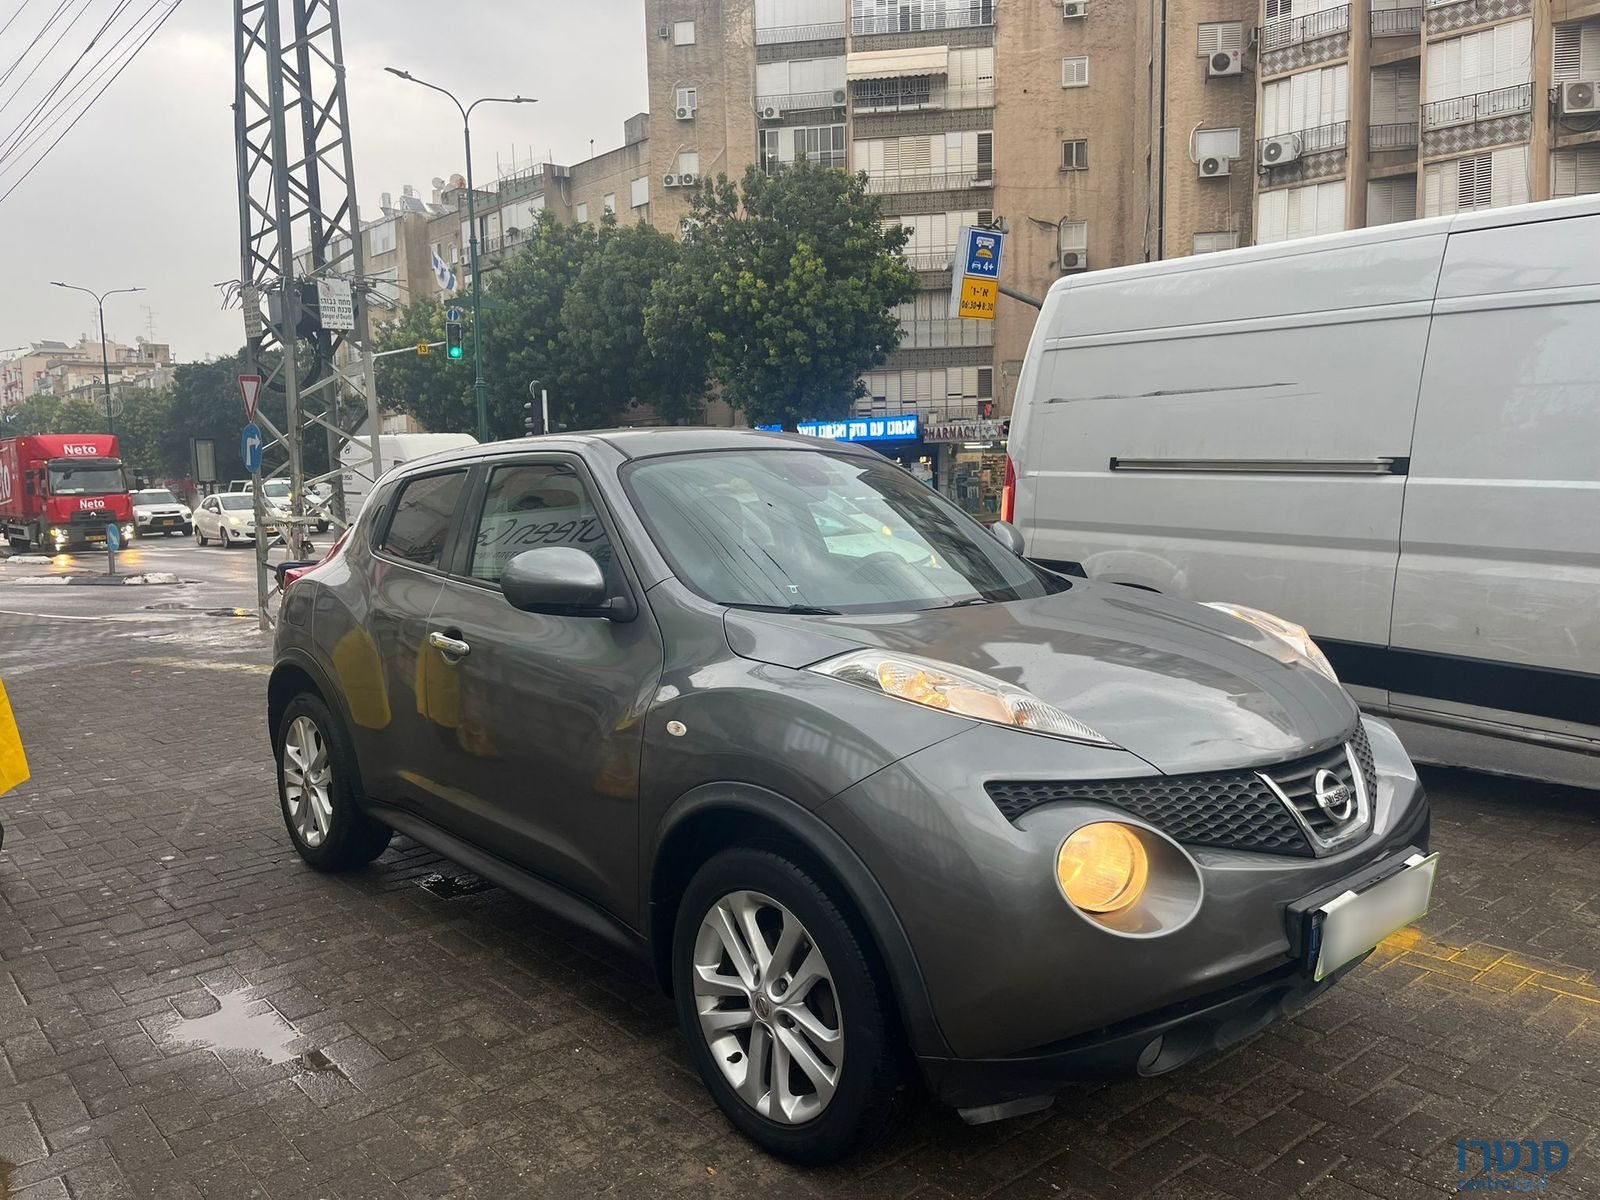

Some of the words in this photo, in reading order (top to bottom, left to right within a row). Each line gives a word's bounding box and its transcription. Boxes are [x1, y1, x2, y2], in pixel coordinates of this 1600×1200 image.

[983, 261, 994, 271] 4+
[849, 423, 868, 440] חזק
[870, 421, 884, 437] עם
[887, 420, 916, 436] אנחנו
[925, 425, 977, 440] PHARMACY
[63, 445, 97, 455] Neto
[80, 499, 105, 509] Neto
